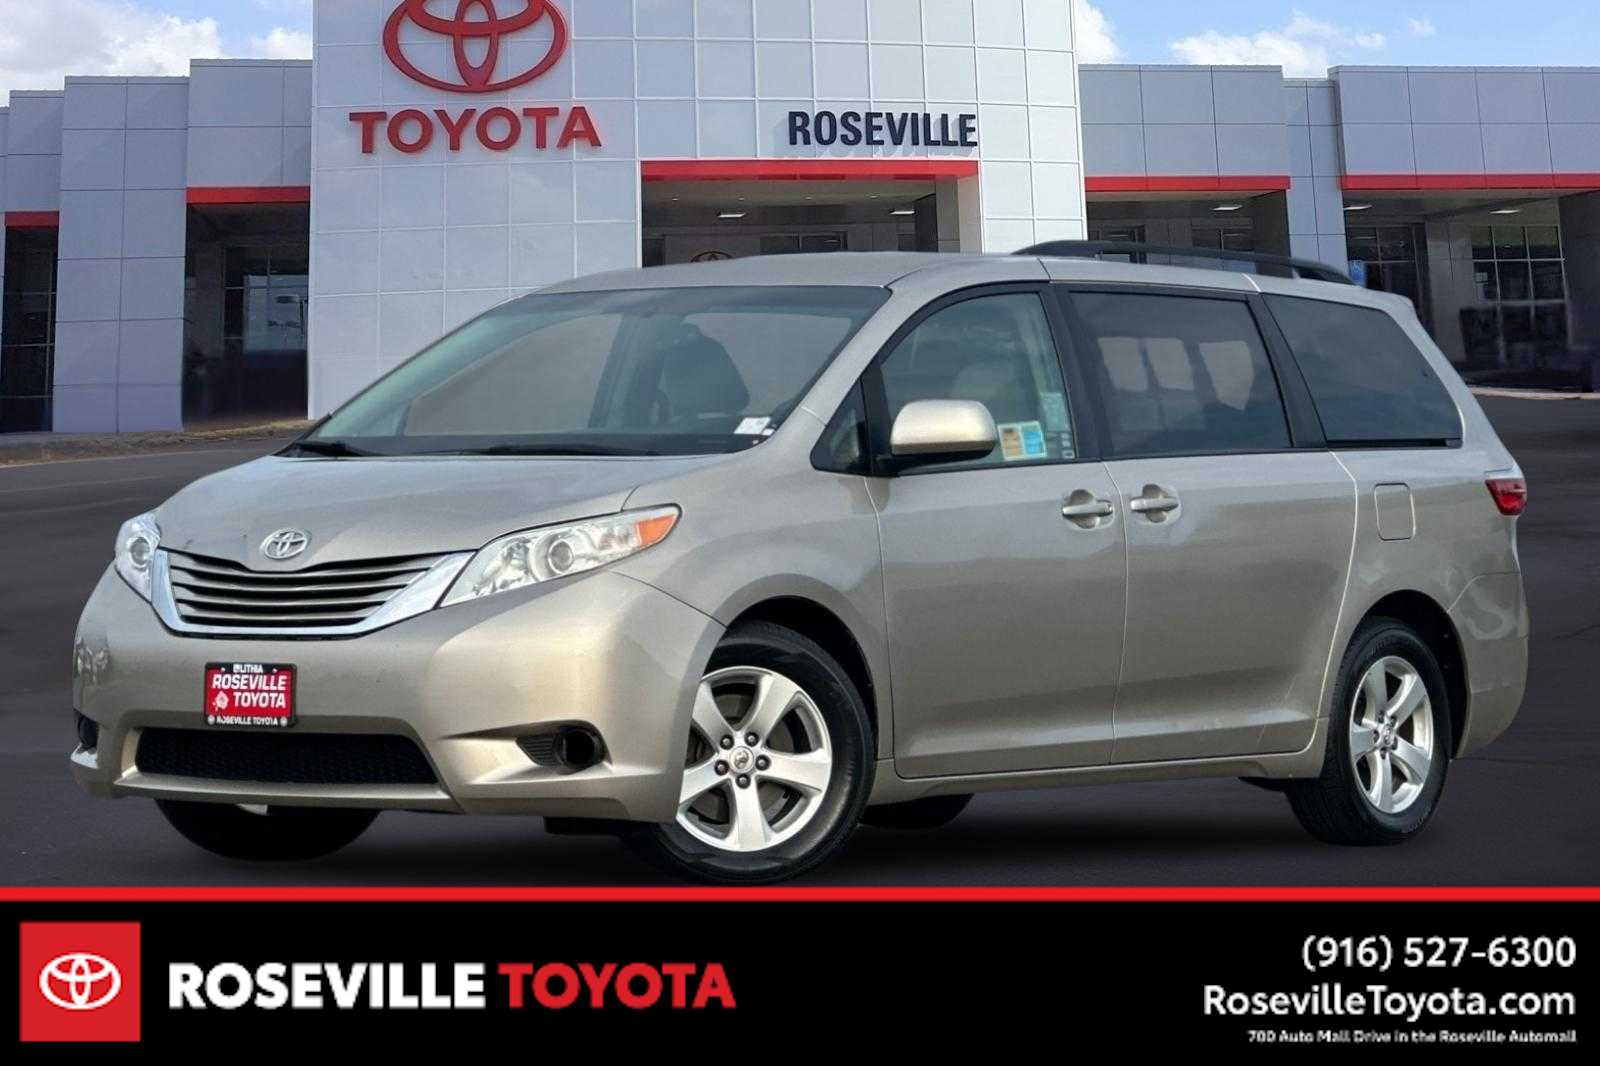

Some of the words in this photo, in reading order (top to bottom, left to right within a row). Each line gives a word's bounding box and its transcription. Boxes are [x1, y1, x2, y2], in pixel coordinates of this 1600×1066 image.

[349, 106, 602, 154] TOYOTA
[788, 110, 979, 147] ROSEVILLE
[212, 674, 288, 691] ROSEVILLE
[233, 691, 286, 708] TOYOTA
[216, 715, 252, 725] ROSEVILLE
[253, 716, 279, 726] TOYOTA
